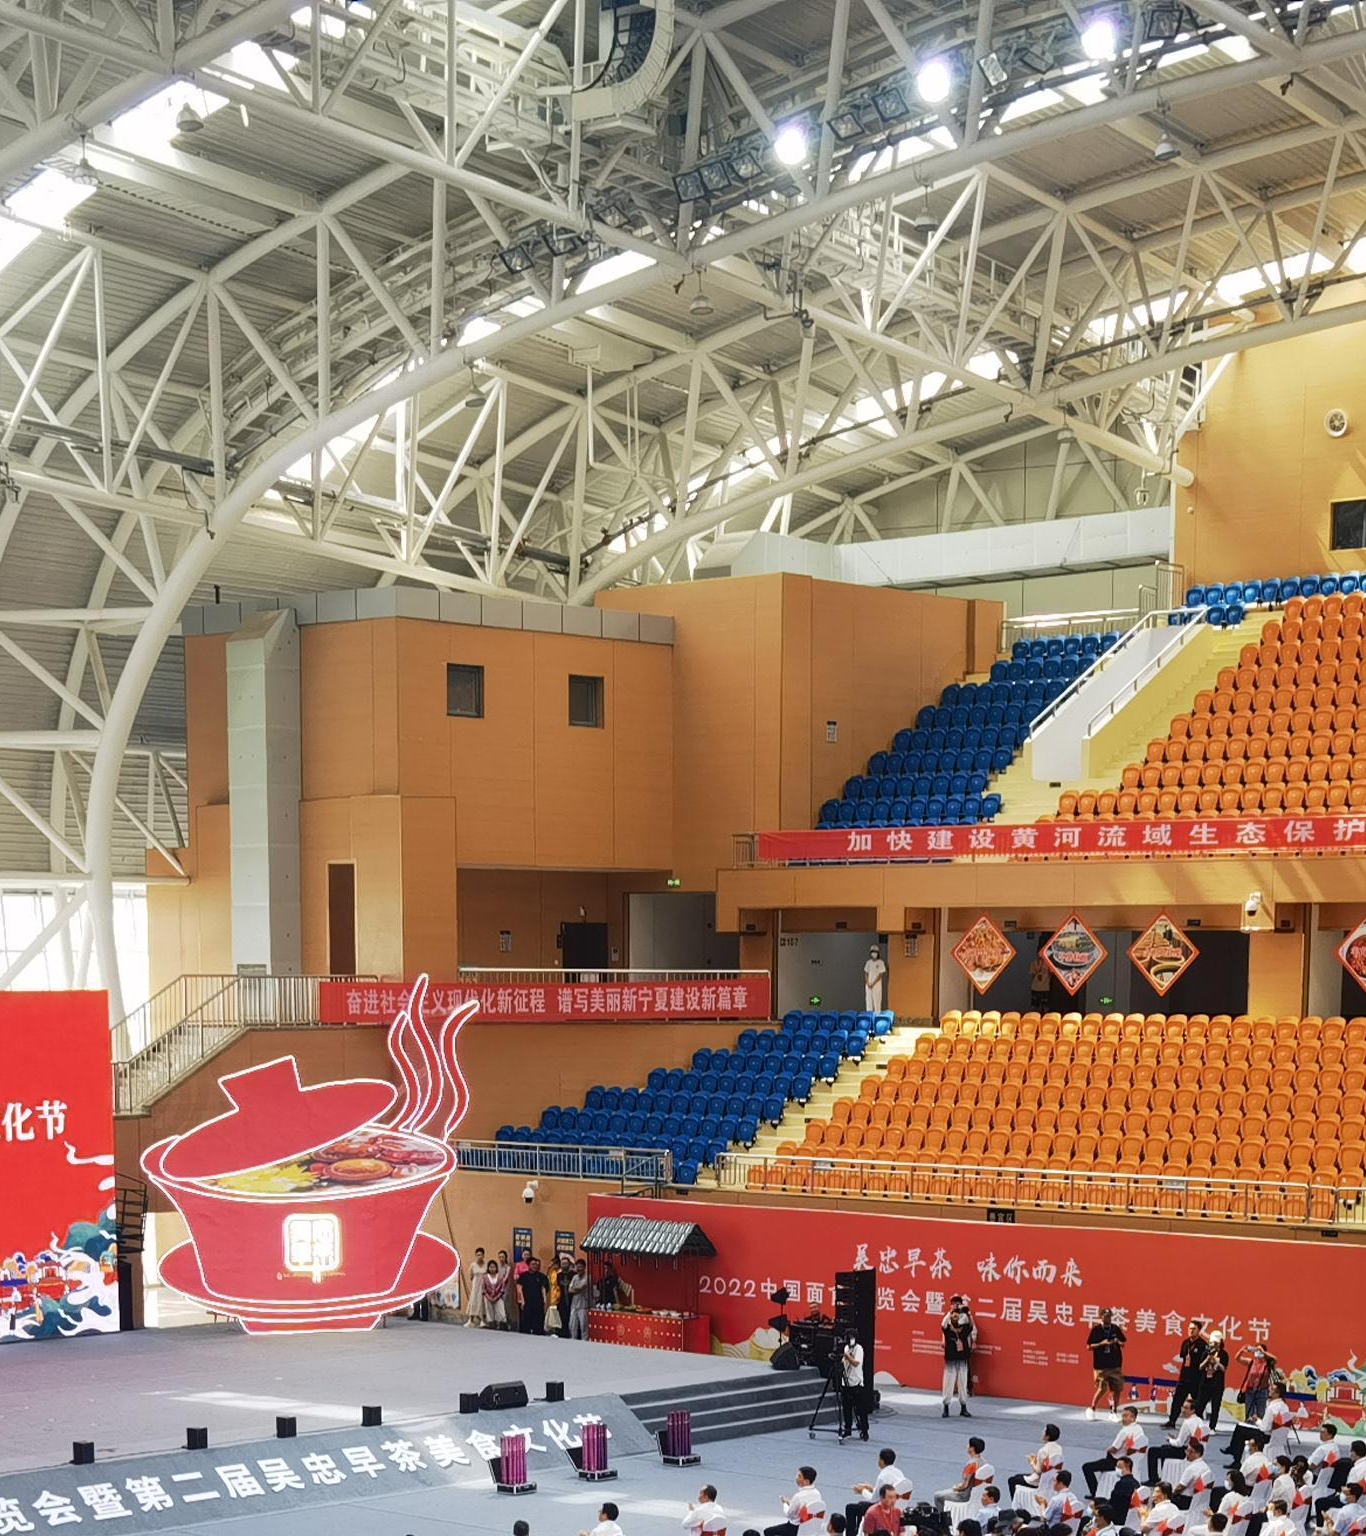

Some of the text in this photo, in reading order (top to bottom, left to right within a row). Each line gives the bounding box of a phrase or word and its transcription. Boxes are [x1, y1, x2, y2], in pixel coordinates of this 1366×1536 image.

[557, 985, 748, 1014] 谱写美丽新宁夏建设新篇章
[853, 1243, 1084, 1288] 吴忠早茶 味你而来
